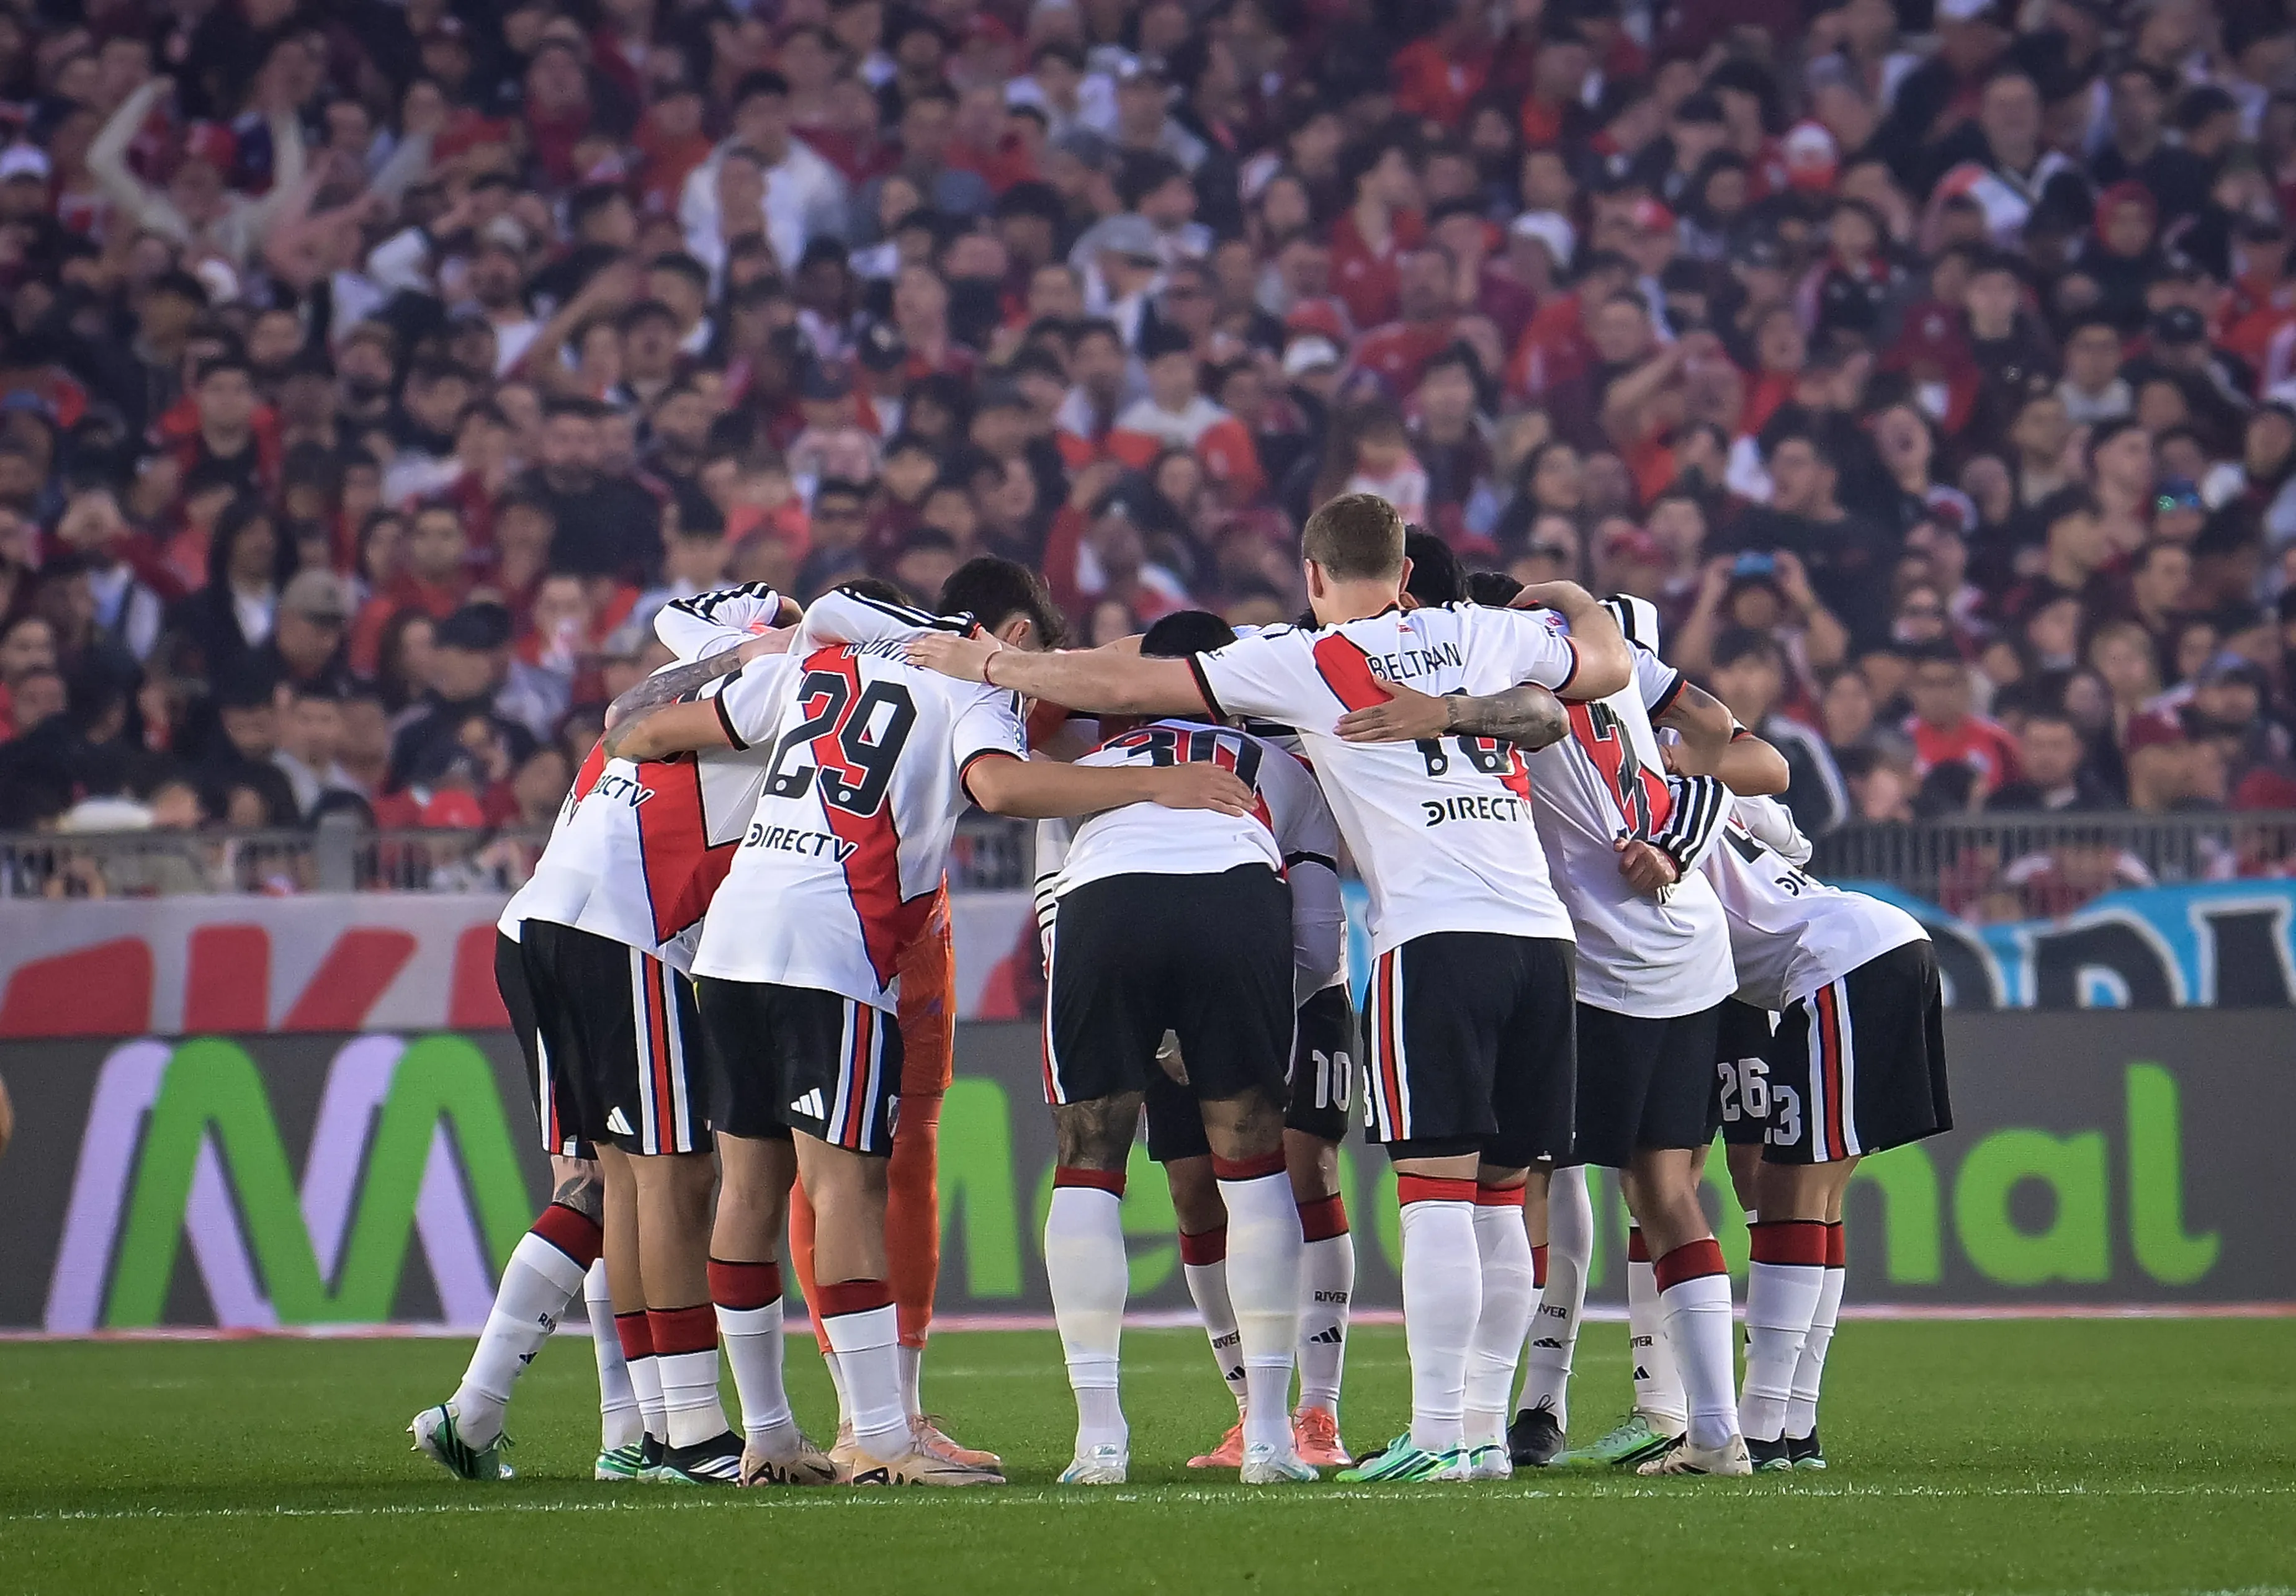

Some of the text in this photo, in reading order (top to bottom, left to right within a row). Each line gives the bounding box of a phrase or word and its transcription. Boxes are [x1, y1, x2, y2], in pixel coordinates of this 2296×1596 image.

[1367, 642, 1463, 682] BELTRAN
[761, 670, 919, 817] 29
[744, 823, 857, 863] DIRECTV
[1312, 1049, 1352, 1111] 10
[1717, 1057, 1769, 1121] 26
[1314, 1290, 1348, 1305] RIVER
